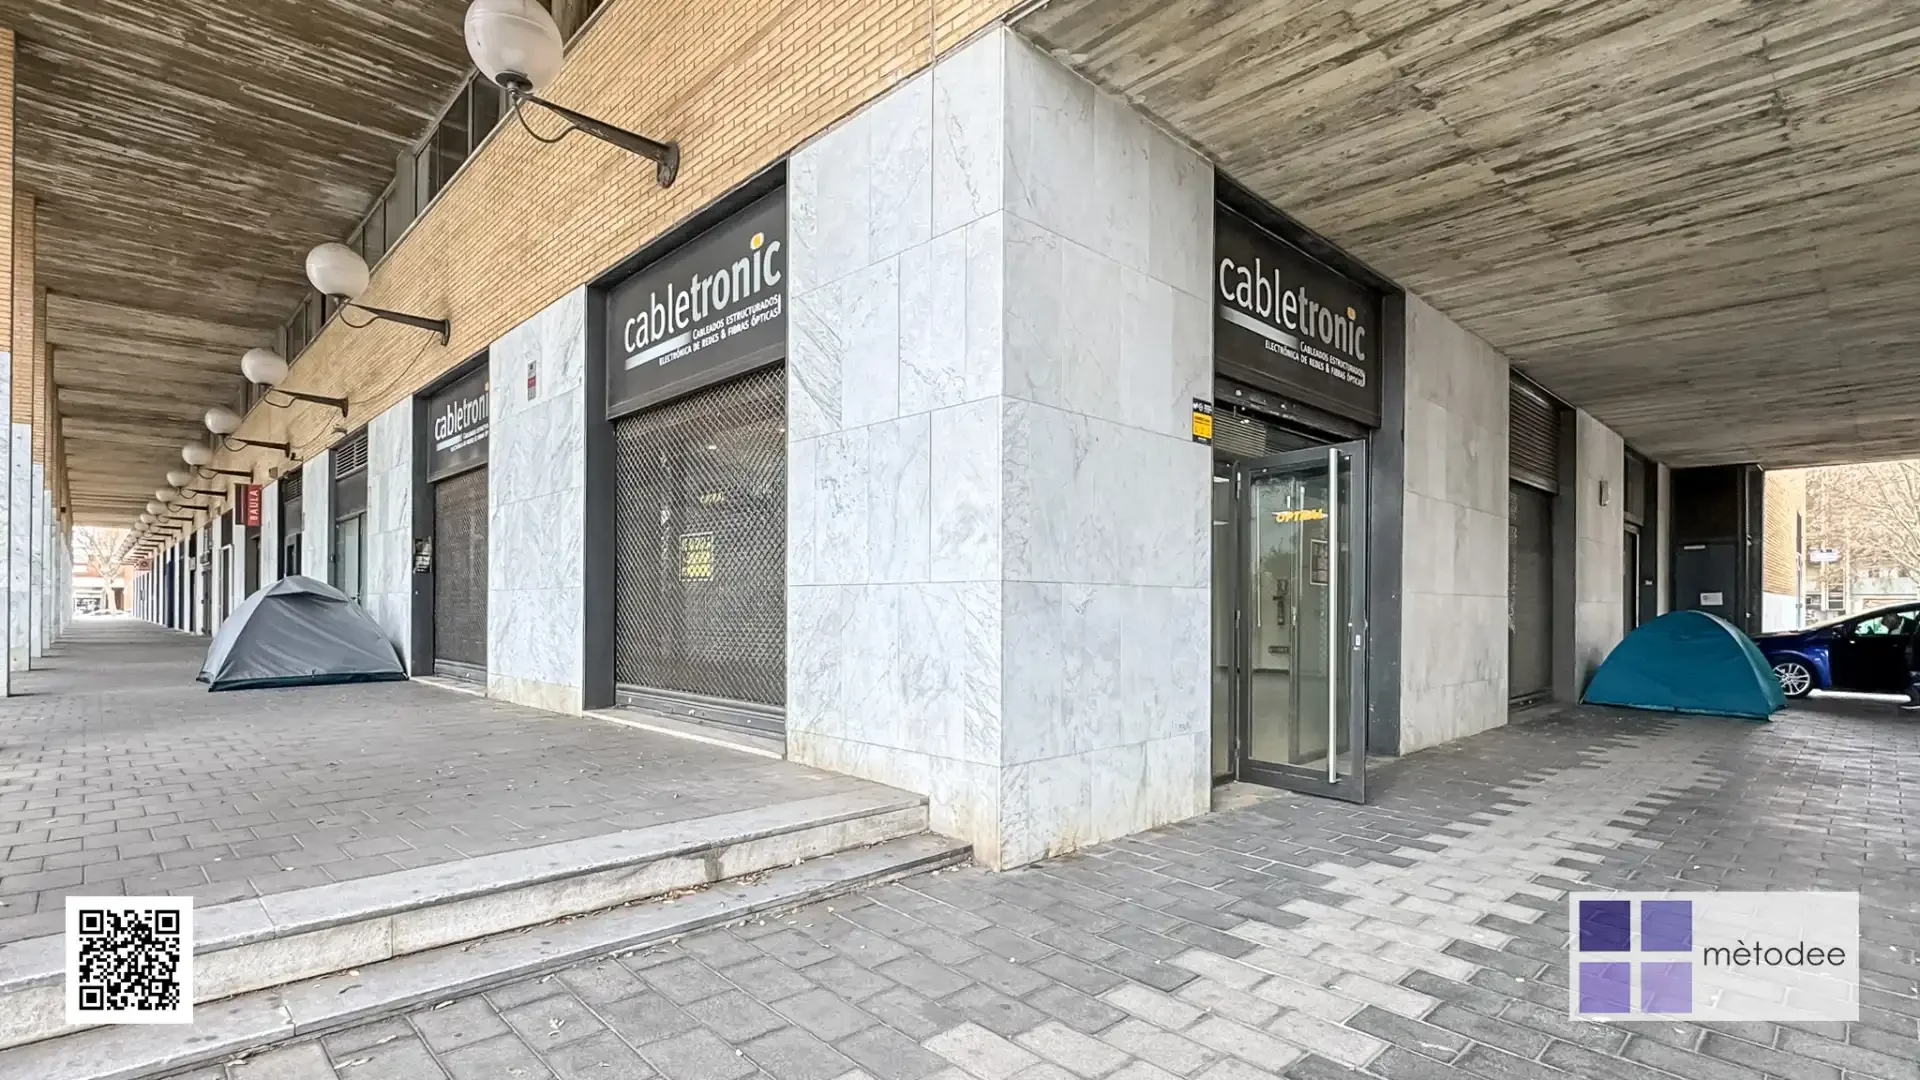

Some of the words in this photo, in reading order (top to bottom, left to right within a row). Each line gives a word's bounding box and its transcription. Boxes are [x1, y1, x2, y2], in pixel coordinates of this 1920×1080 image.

[624, 232, 782, 353] cabletronic
[1219, 257, 1366, 361] cabletronic
[692, 341, 701, 352] DE
[701, 332, 720, 348] REDES
[720, 328, 727, 340] &
[1300, 354, 1308, 365] DE
[1309, 357, 1325, 371] REDES
[1325, 362, 1330, 374] &
[434, 382, 489, 441] cabletroni
